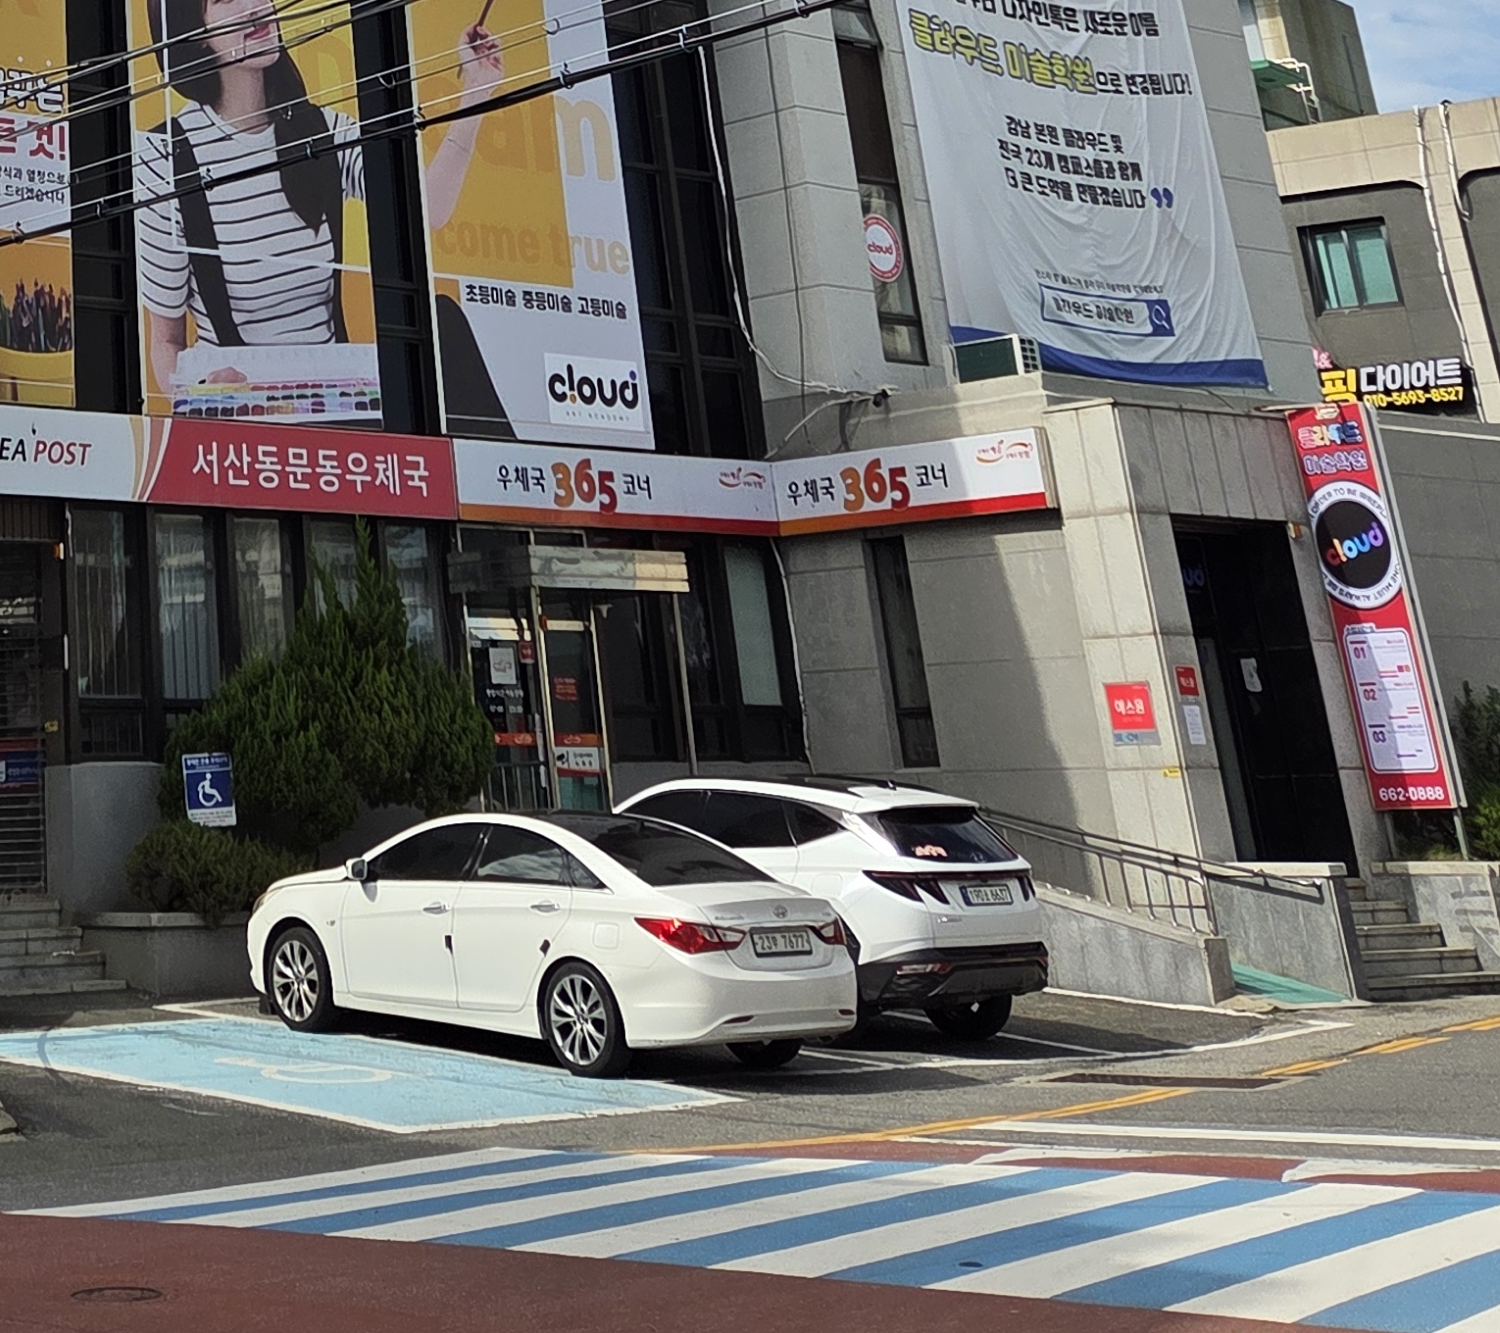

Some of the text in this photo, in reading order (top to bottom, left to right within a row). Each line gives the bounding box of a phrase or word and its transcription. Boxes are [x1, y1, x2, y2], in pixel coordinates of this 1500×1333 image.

[909, 7, 1004, 76] 클라우드
[1061, 127, 1110, 153] 클라우드
[465, 284, 627, 320] 초등미술 중등미술 고등미술
[1360, 358, 1462, 393] 다이어트
[33, 439, 92, 467] POST
[192, 441, 430, 497] 서산동문동우체국
[496, 458, 652, 514] 우체국 365 코너
[787, 477, 835, 506] 우체국
[839, 457, 911, 512] 365
[915, 463, 948, 488] 코너
